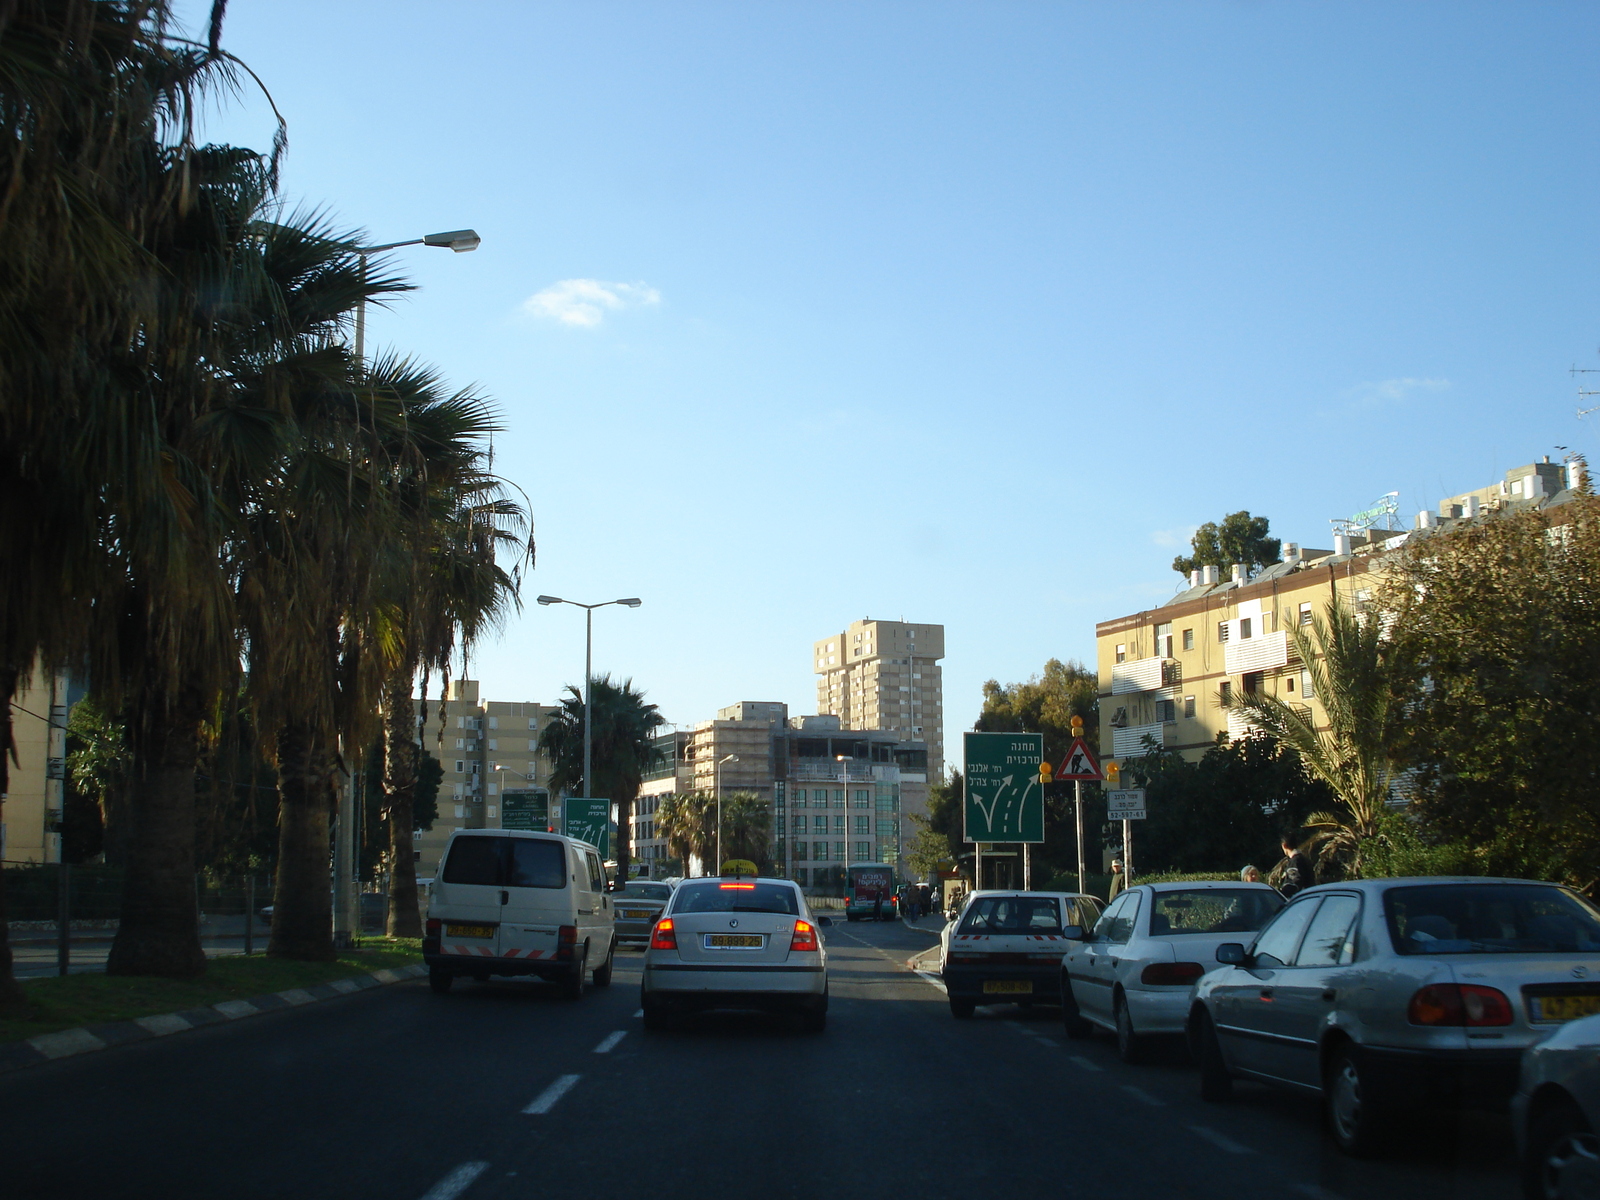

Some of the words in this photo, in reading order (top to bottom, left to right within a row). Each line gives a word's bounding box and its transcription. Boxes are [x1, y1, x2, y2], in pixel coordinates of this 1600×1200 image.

[1011, 742, 1035, 751] תחנה
[1006, 755, 1040, 764] מרכזית
[967, 763, 989, 773] אלנבי
